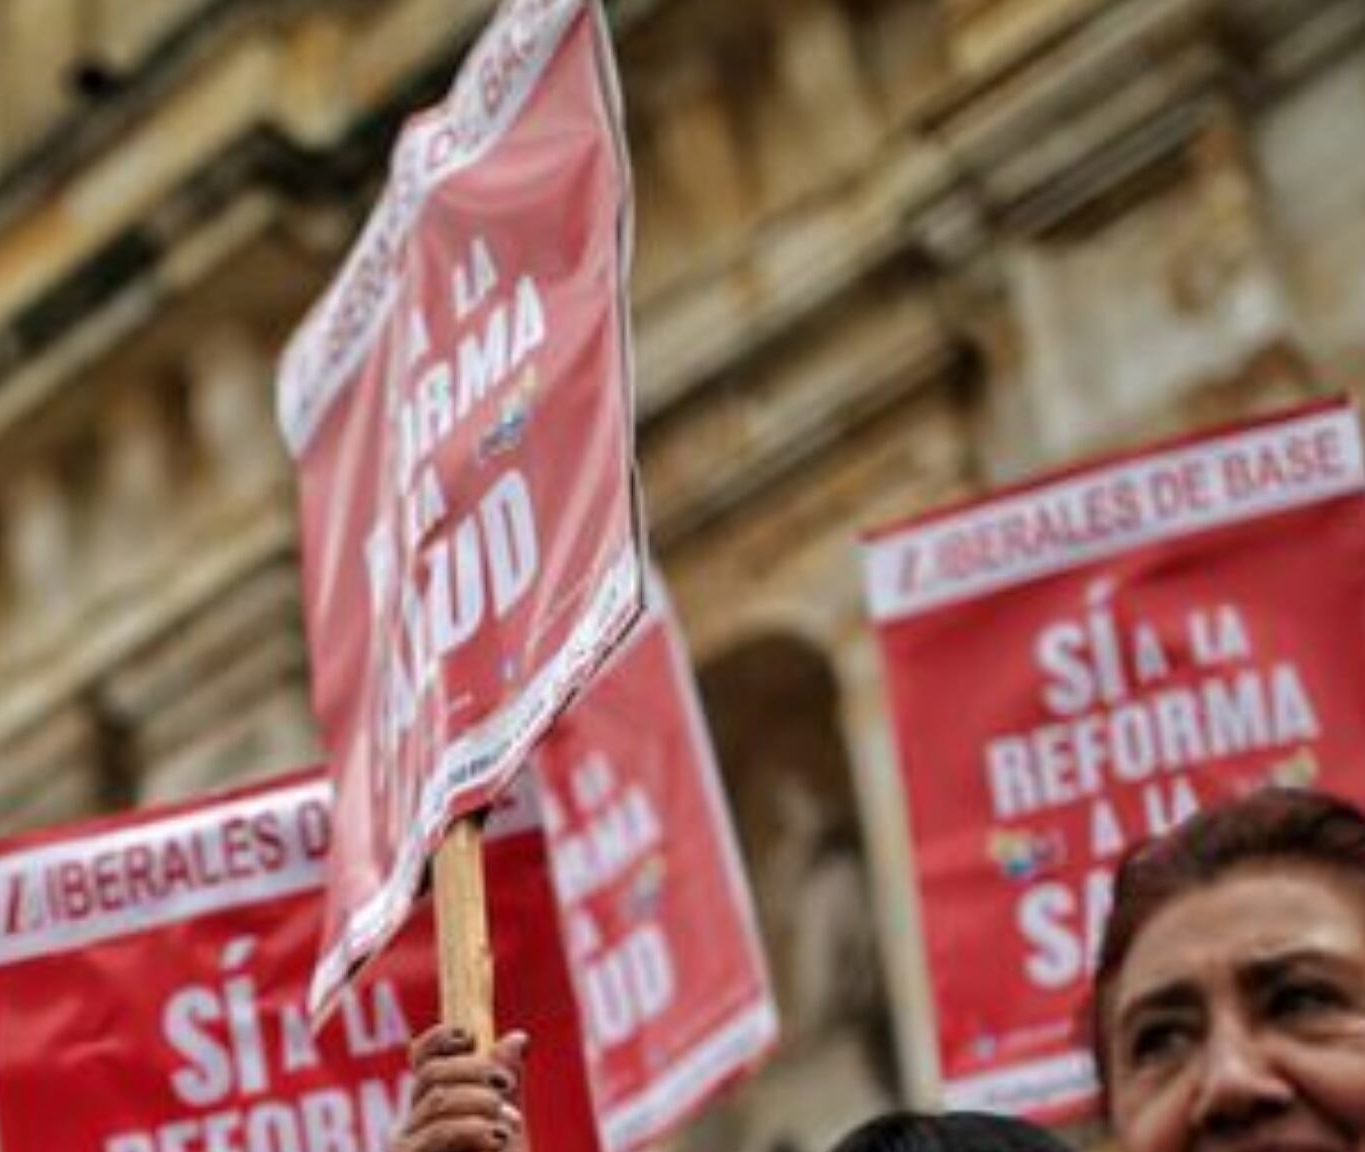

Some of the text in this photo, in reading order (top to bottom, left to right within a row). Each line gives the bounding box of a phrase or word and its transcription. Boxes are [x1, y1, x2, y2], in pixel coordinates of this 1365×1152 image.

[899, 427, 1346, 596] LIBERALES DE BASE
[1035, 572, 1251, 715] SÍ A LA
[985, 662, 1320, 820] REFORMA
[3, 810, 287, 936] LIBERALES
[1091, 797, 1124, 858] A
[161, 935, 270, 1108] SÍ
[339, 978, 413, 1057] LA
